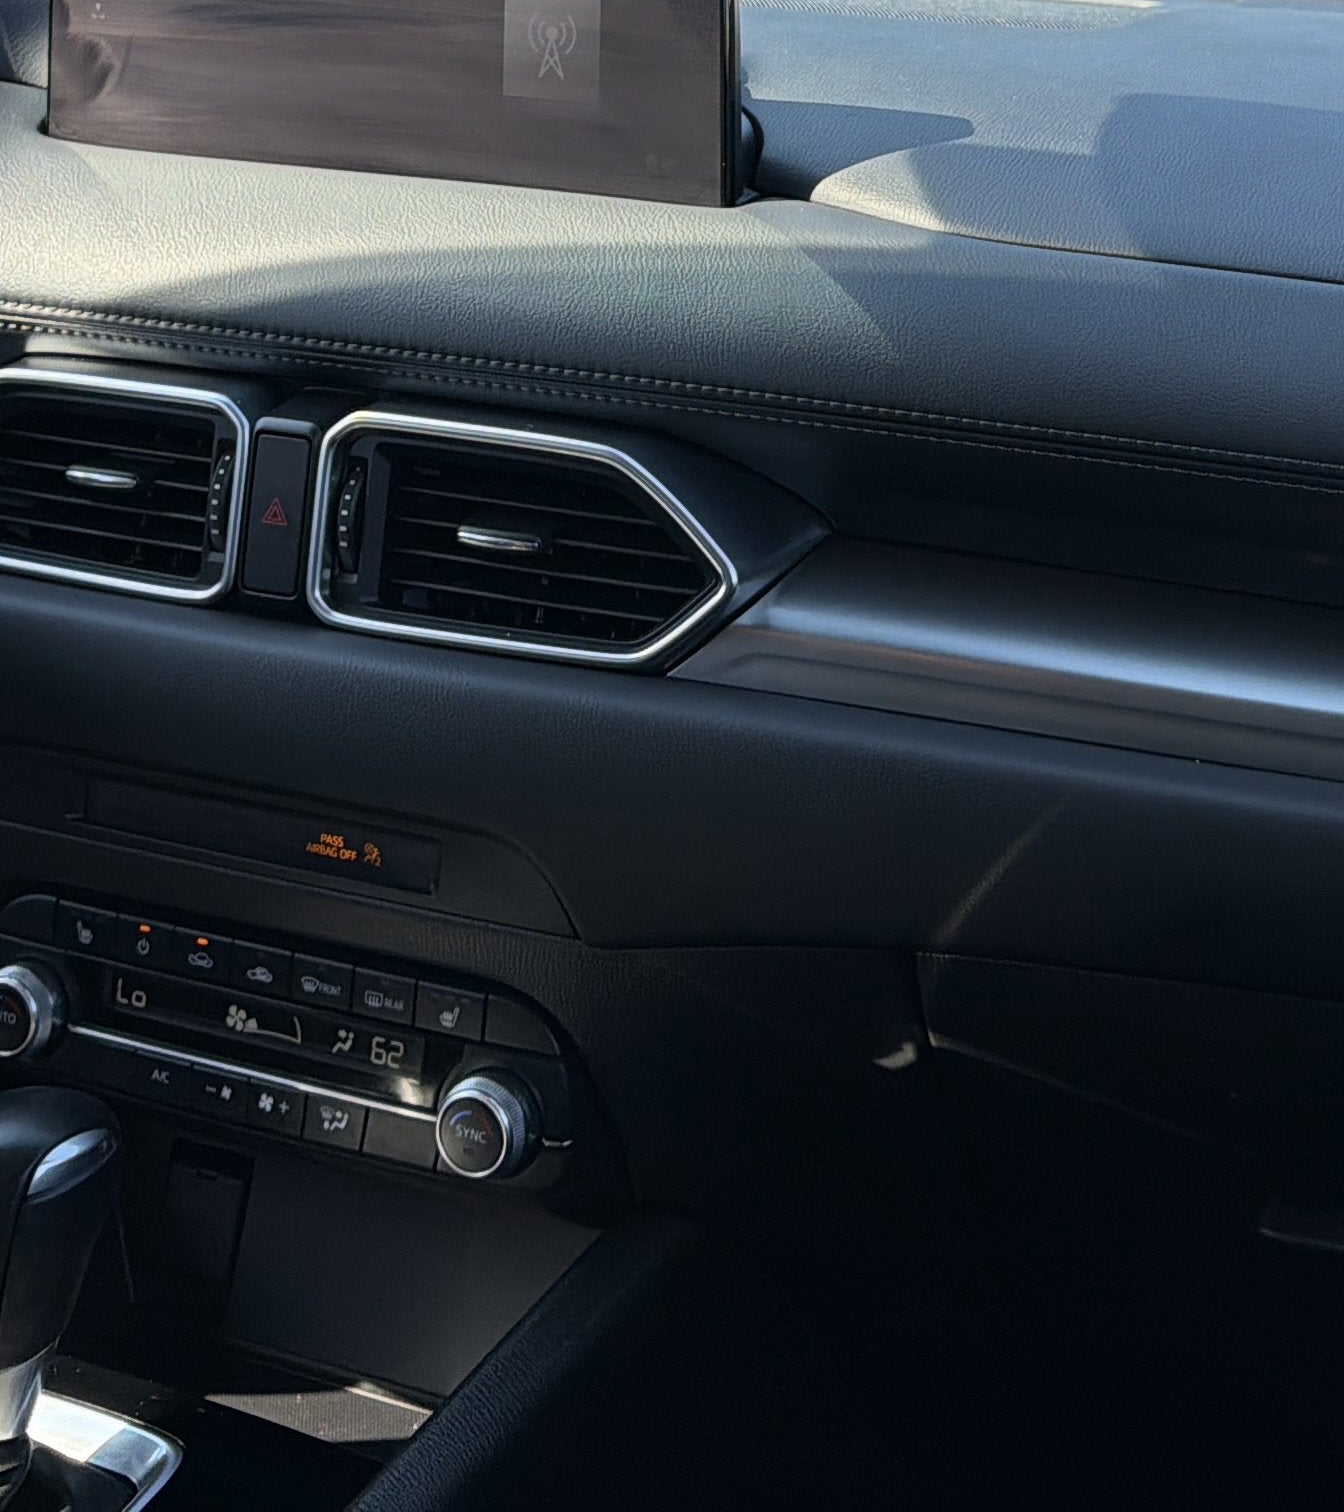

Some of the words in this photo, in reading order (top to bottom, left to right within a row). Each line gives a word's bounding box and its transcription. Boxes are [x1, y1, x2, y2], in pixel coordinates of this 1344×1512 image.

[320, 833, 344, 848] PASS
[306, 842, 338, 858] AIRBAG
[339, 849, 358, 861] OFF
[383, 997, 405, 1011] REAR
[370, 1036, 405, 1069] 62
[150, 1068, 170, 1084] A/C
[456, 1123, 487, 1144] SYNC
